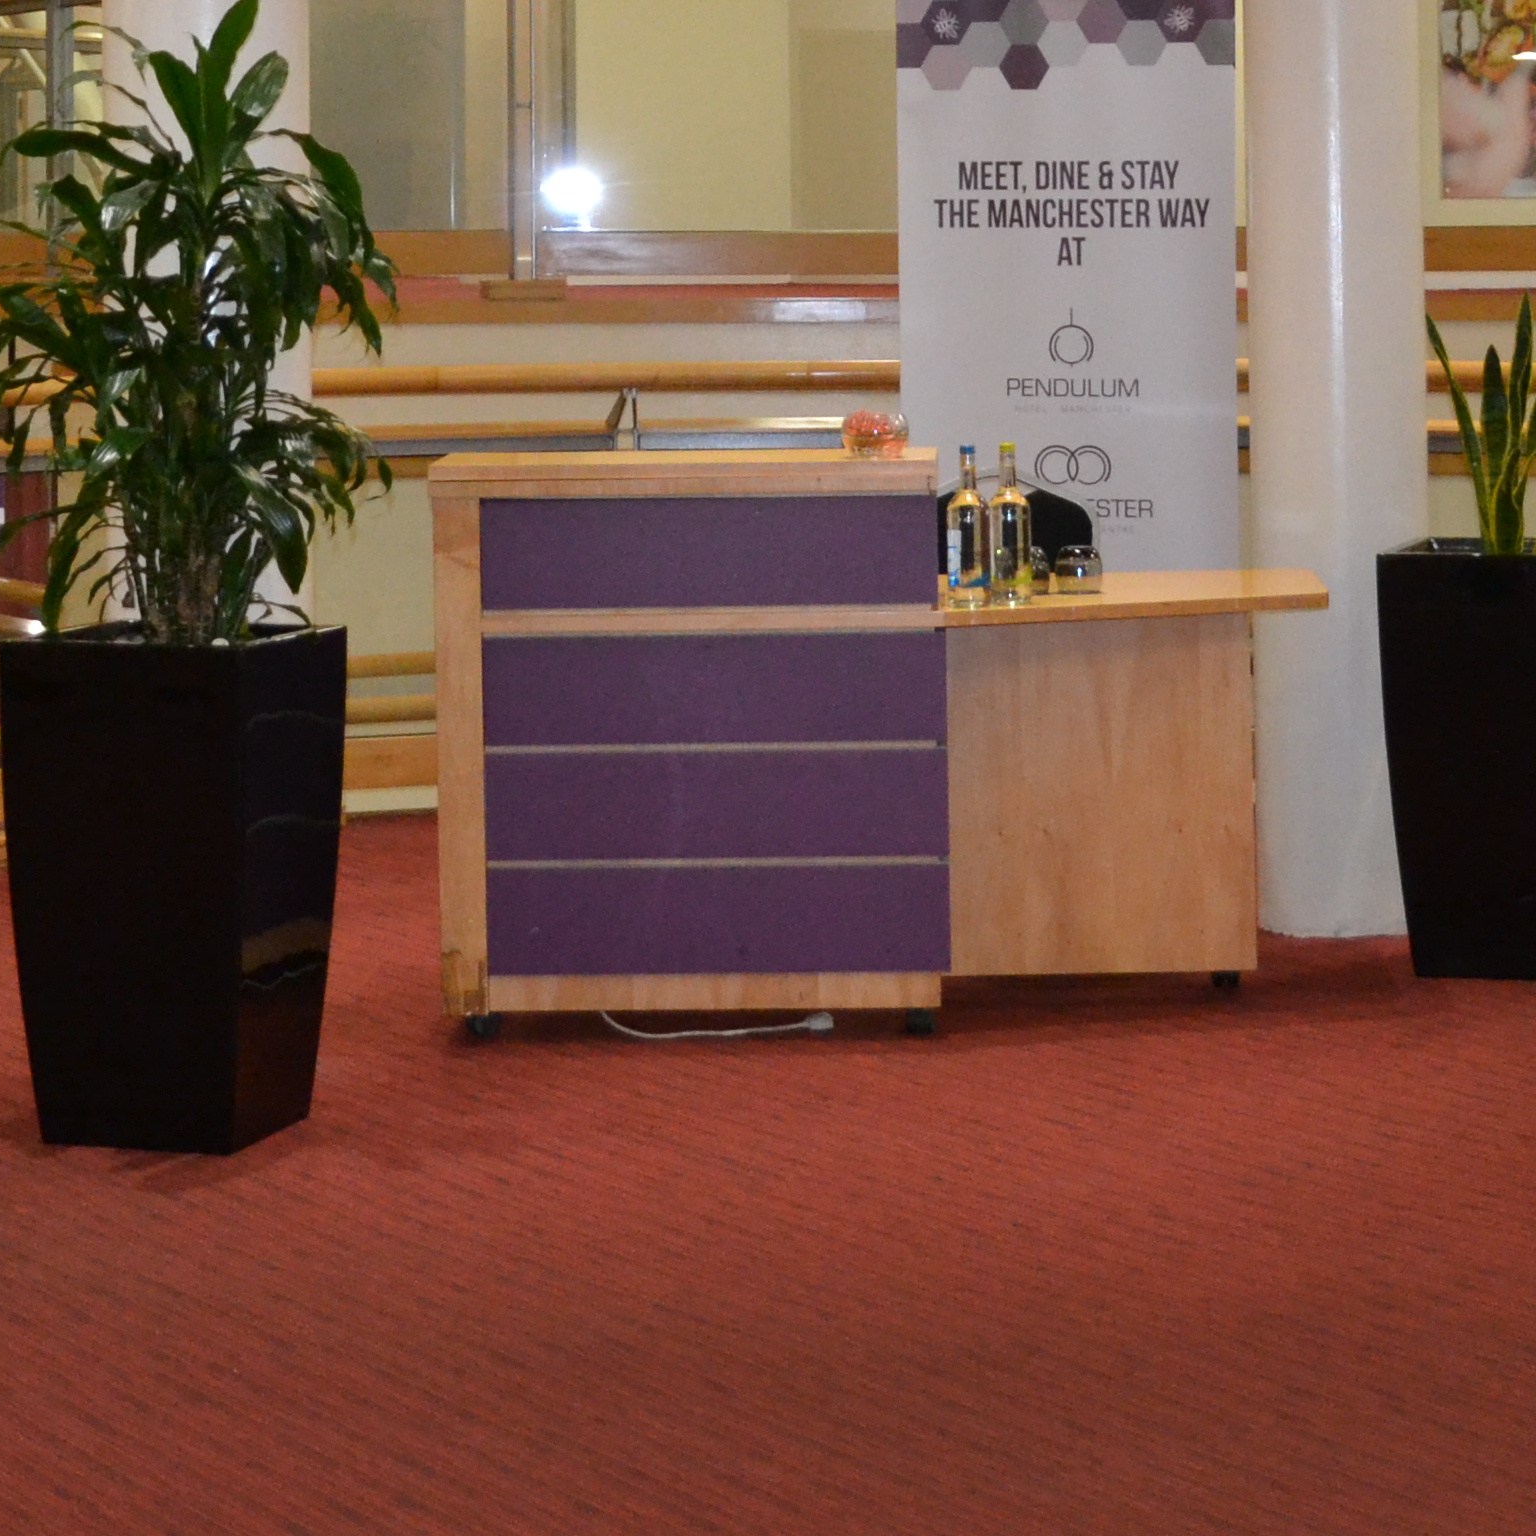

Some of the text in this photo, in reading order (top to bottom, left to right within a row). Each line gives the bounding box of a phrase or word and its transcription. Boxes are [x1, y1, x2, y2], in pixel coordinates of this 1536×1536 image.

[958, 160, 1179, 194] MEET, DINE & STAY
[934, 198, 1210, 228] THE MANCHESTER WAY
[1056, 236, 1086, 266] AT
[1006, 377, 1140, 398] PENDULUM
